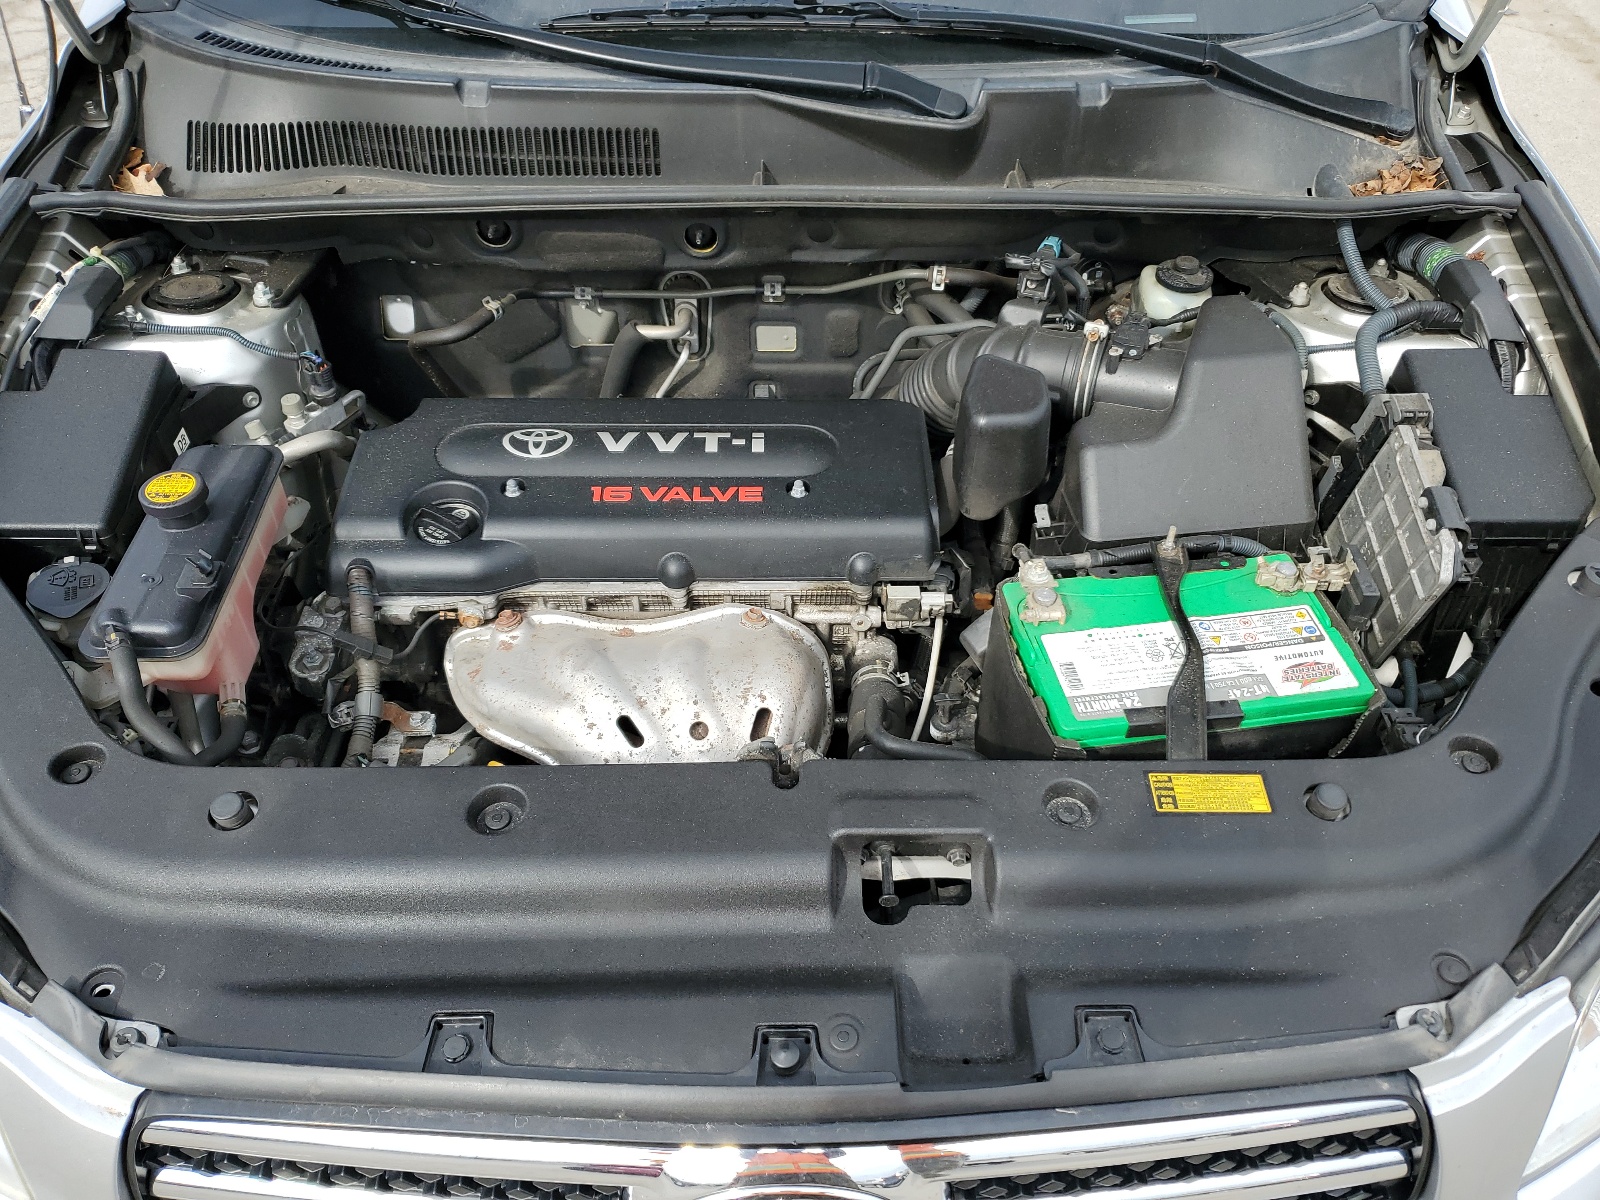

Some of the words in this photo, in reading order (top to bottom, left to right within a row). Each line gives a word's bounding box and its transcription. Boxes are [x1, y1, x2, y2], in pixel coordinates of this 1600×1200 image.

[596, 431, 765, 453] VVT-i
[590, 486, 634, 503] 16
[639, 486, 764, 503] VALVE
[1273, 649, 1324, 662] AUTOMOTIVE
[1283, 662, 1335, 676] BATTERIES
[1283, 668, 1341, 683] INTERSTATE
[1073, 693, 1120, 703] REPLACEMENT
[1074, 696, 1143, 714] 24-MONTH
